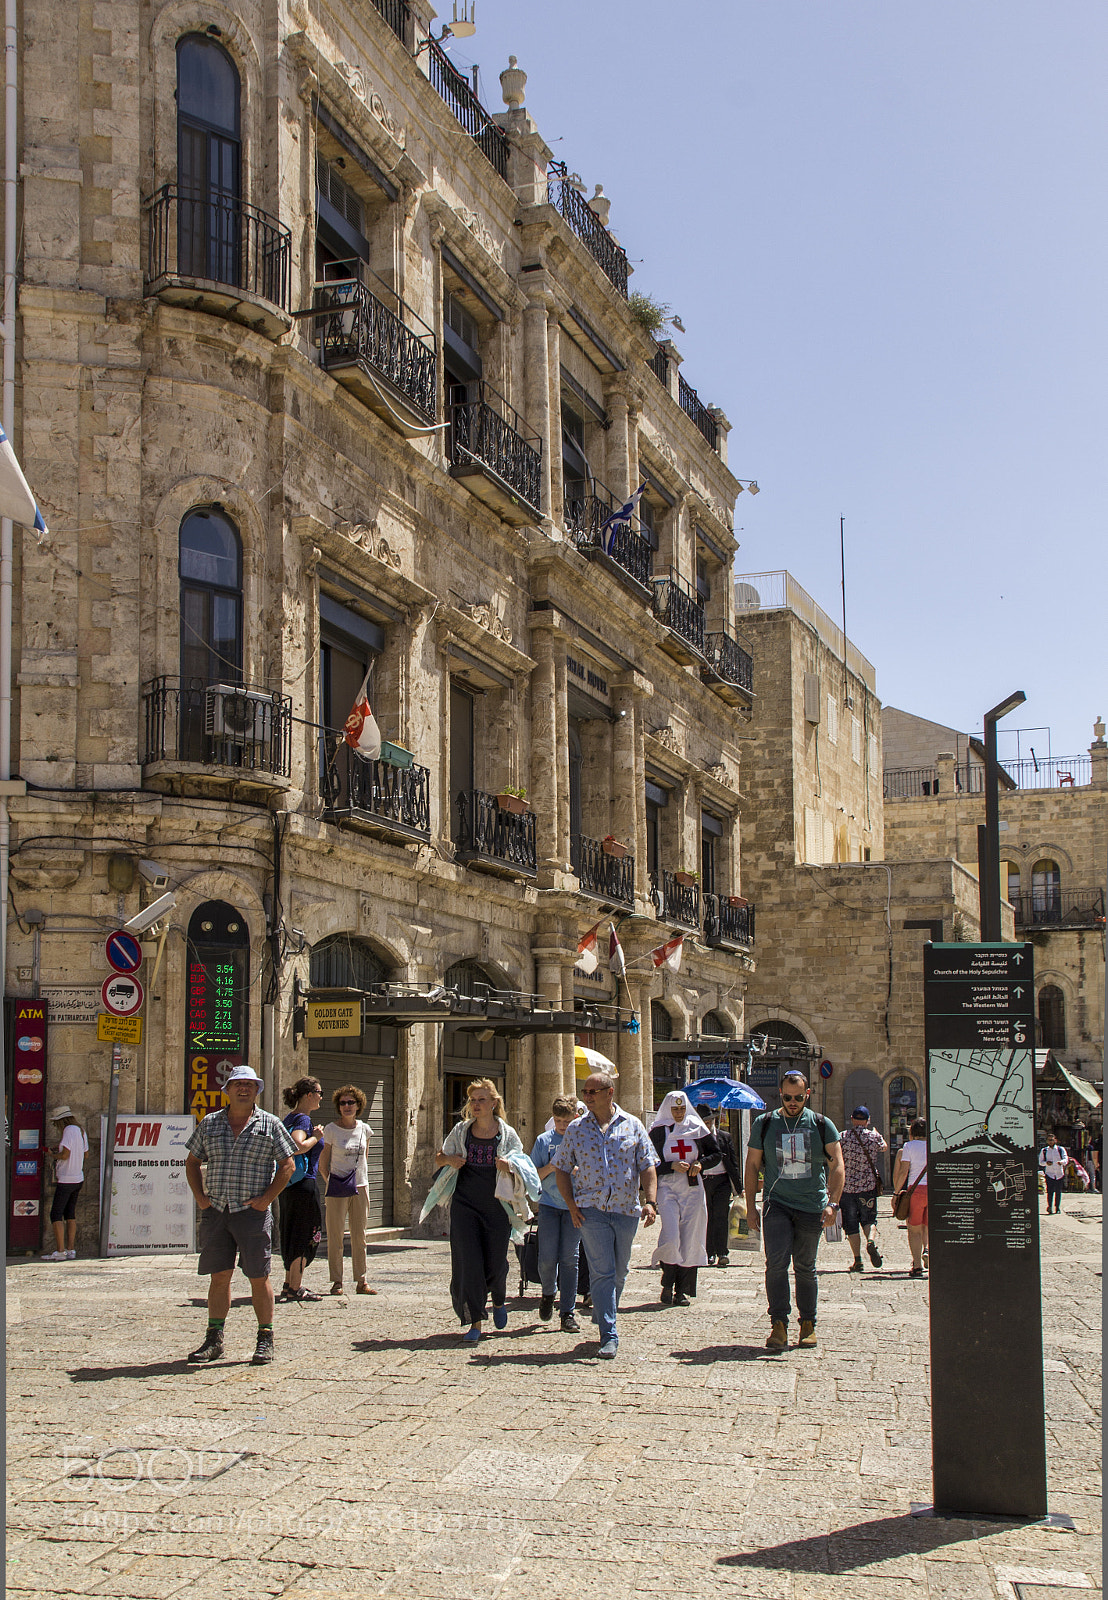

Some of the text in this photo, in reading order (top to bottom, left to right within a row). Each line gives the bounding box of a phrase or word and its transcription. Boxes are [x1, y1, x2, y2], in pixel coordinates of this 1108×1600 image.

[190, 964, 206, 972] USD
[190, 975, 234, 985] EUR 4.16
[190, 998, 206, 1007] CHF
[18, 1009, 43, 1019] ATM
[190, 1010, 232, 1020] CAD 2.71
[314, 1008, 353, 1018] GOLDEN GATE
[190, 1021, 232, 1030] AUD 2.63
[318, 1020, 350, 1030] SOUVENIRS
[115, 1122, 162, 1146] ATM
[114, 1159, 136, 1168] hange
[138, 1159, 158, 1167] Rates
